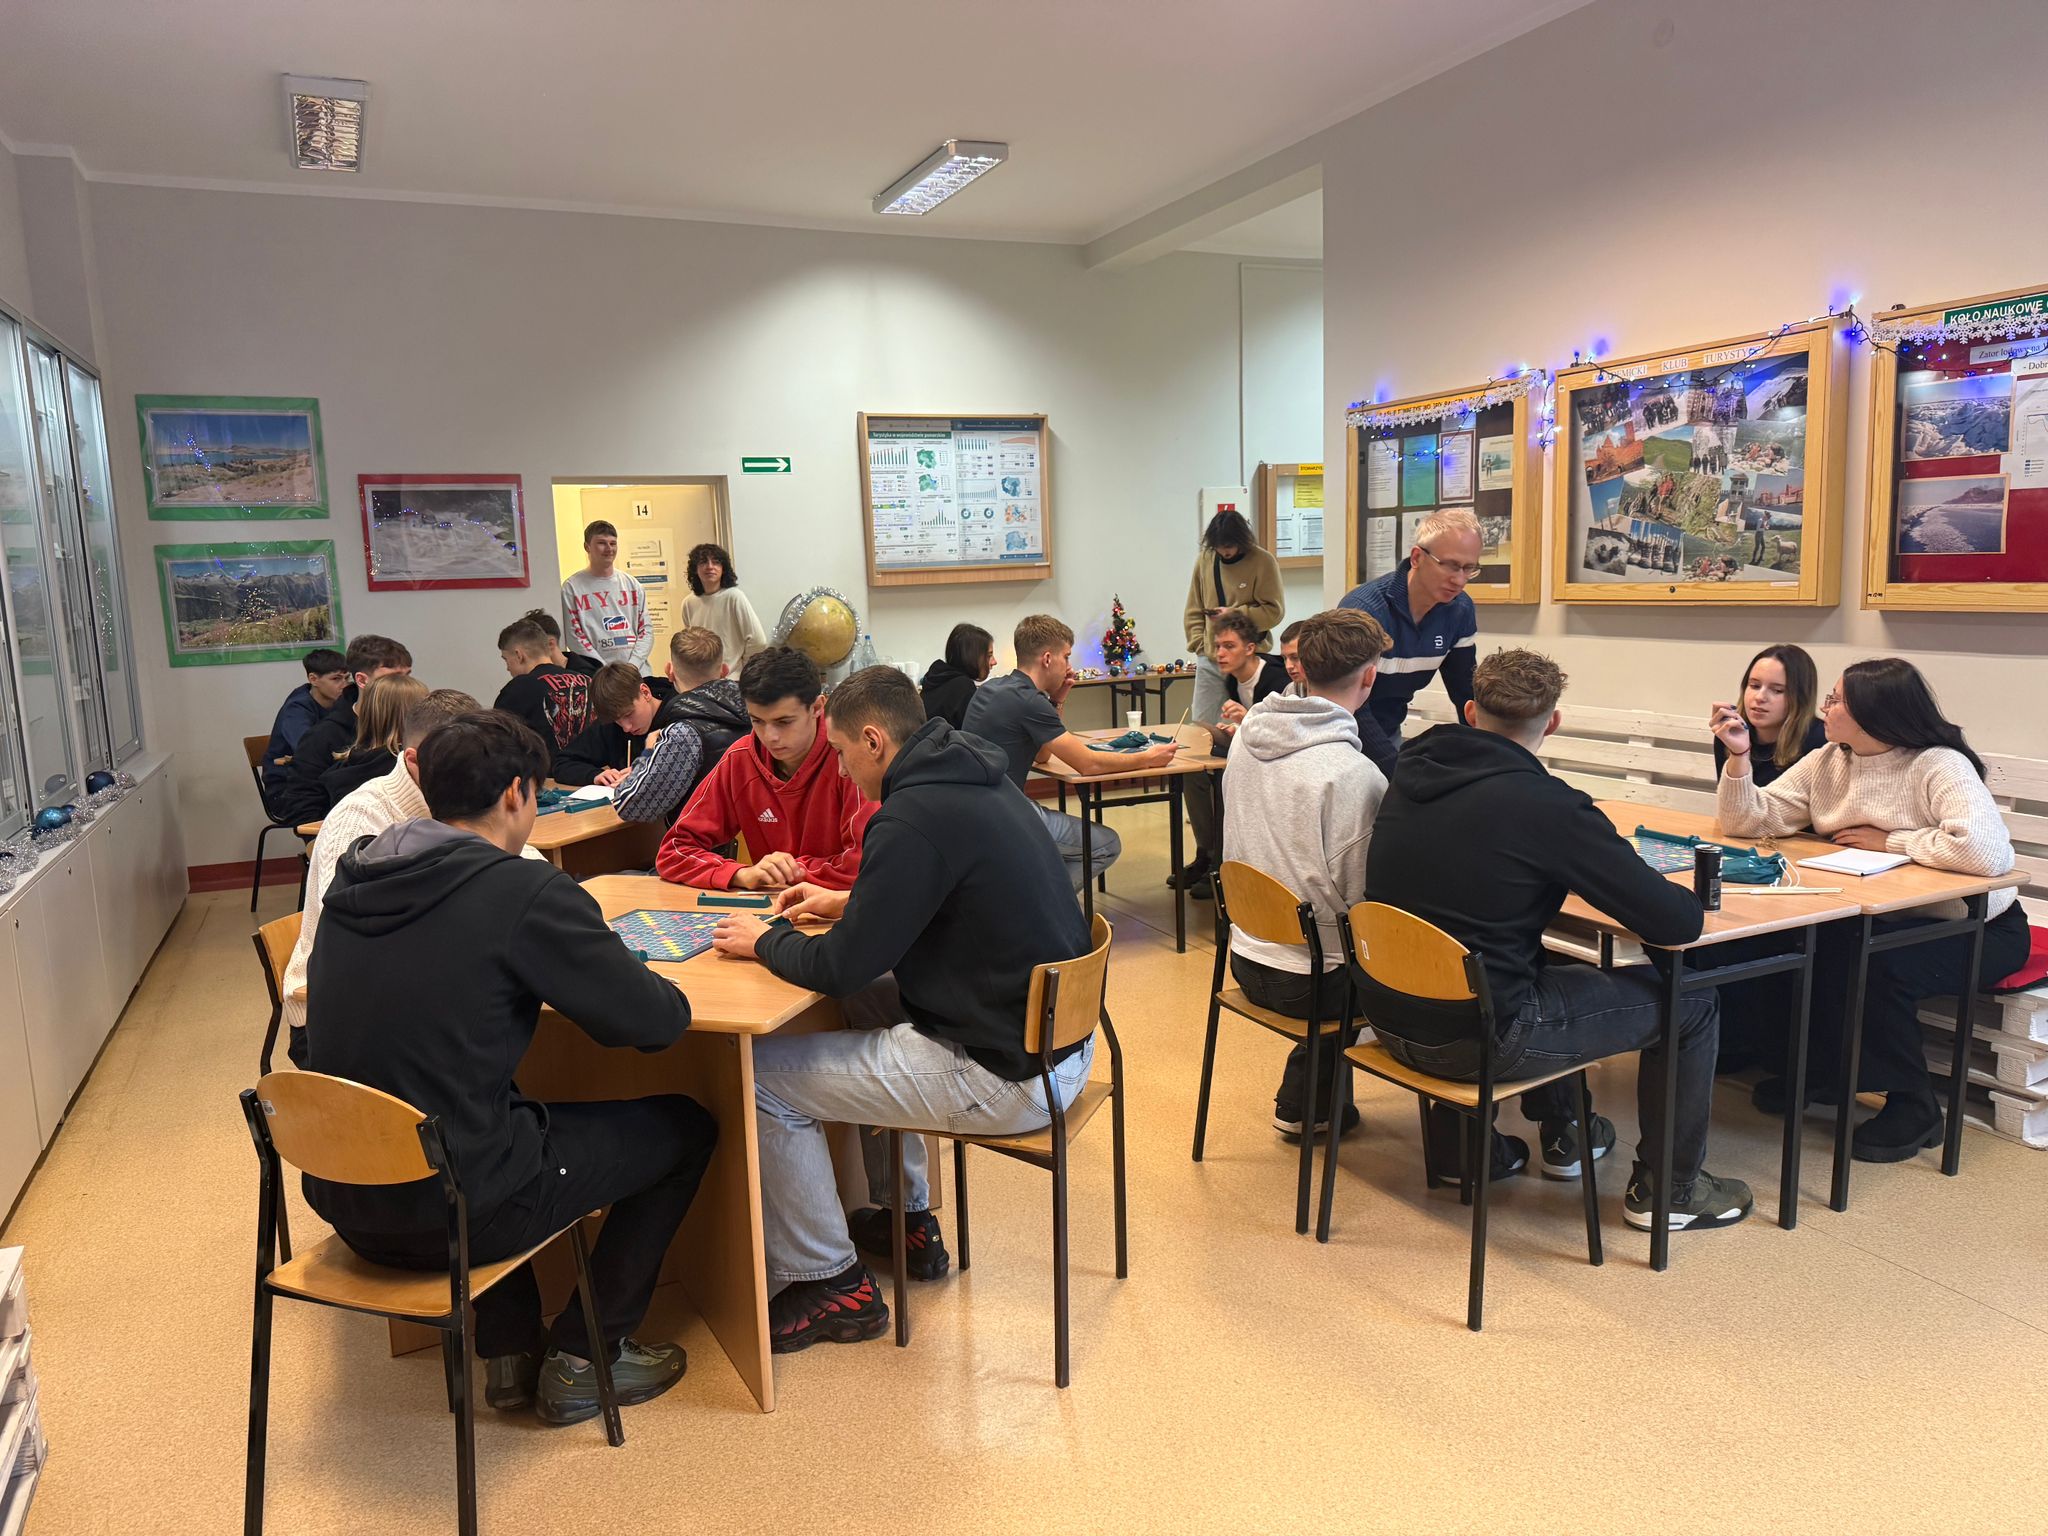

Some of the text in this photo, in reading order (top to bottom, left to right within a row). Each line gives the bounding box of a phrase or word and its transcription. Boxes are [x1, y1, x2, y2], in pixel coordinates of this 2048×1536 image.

[1950, 310, 1981, 326] KOŁO
[1983, 299, 2043, 320] NAUKOWE
[1595, 346, 1764, 382] EMICKI KLUB TURYSTY
[1978, 350, 1999, 360] Zator
[636, 505, 648, 516] 14
